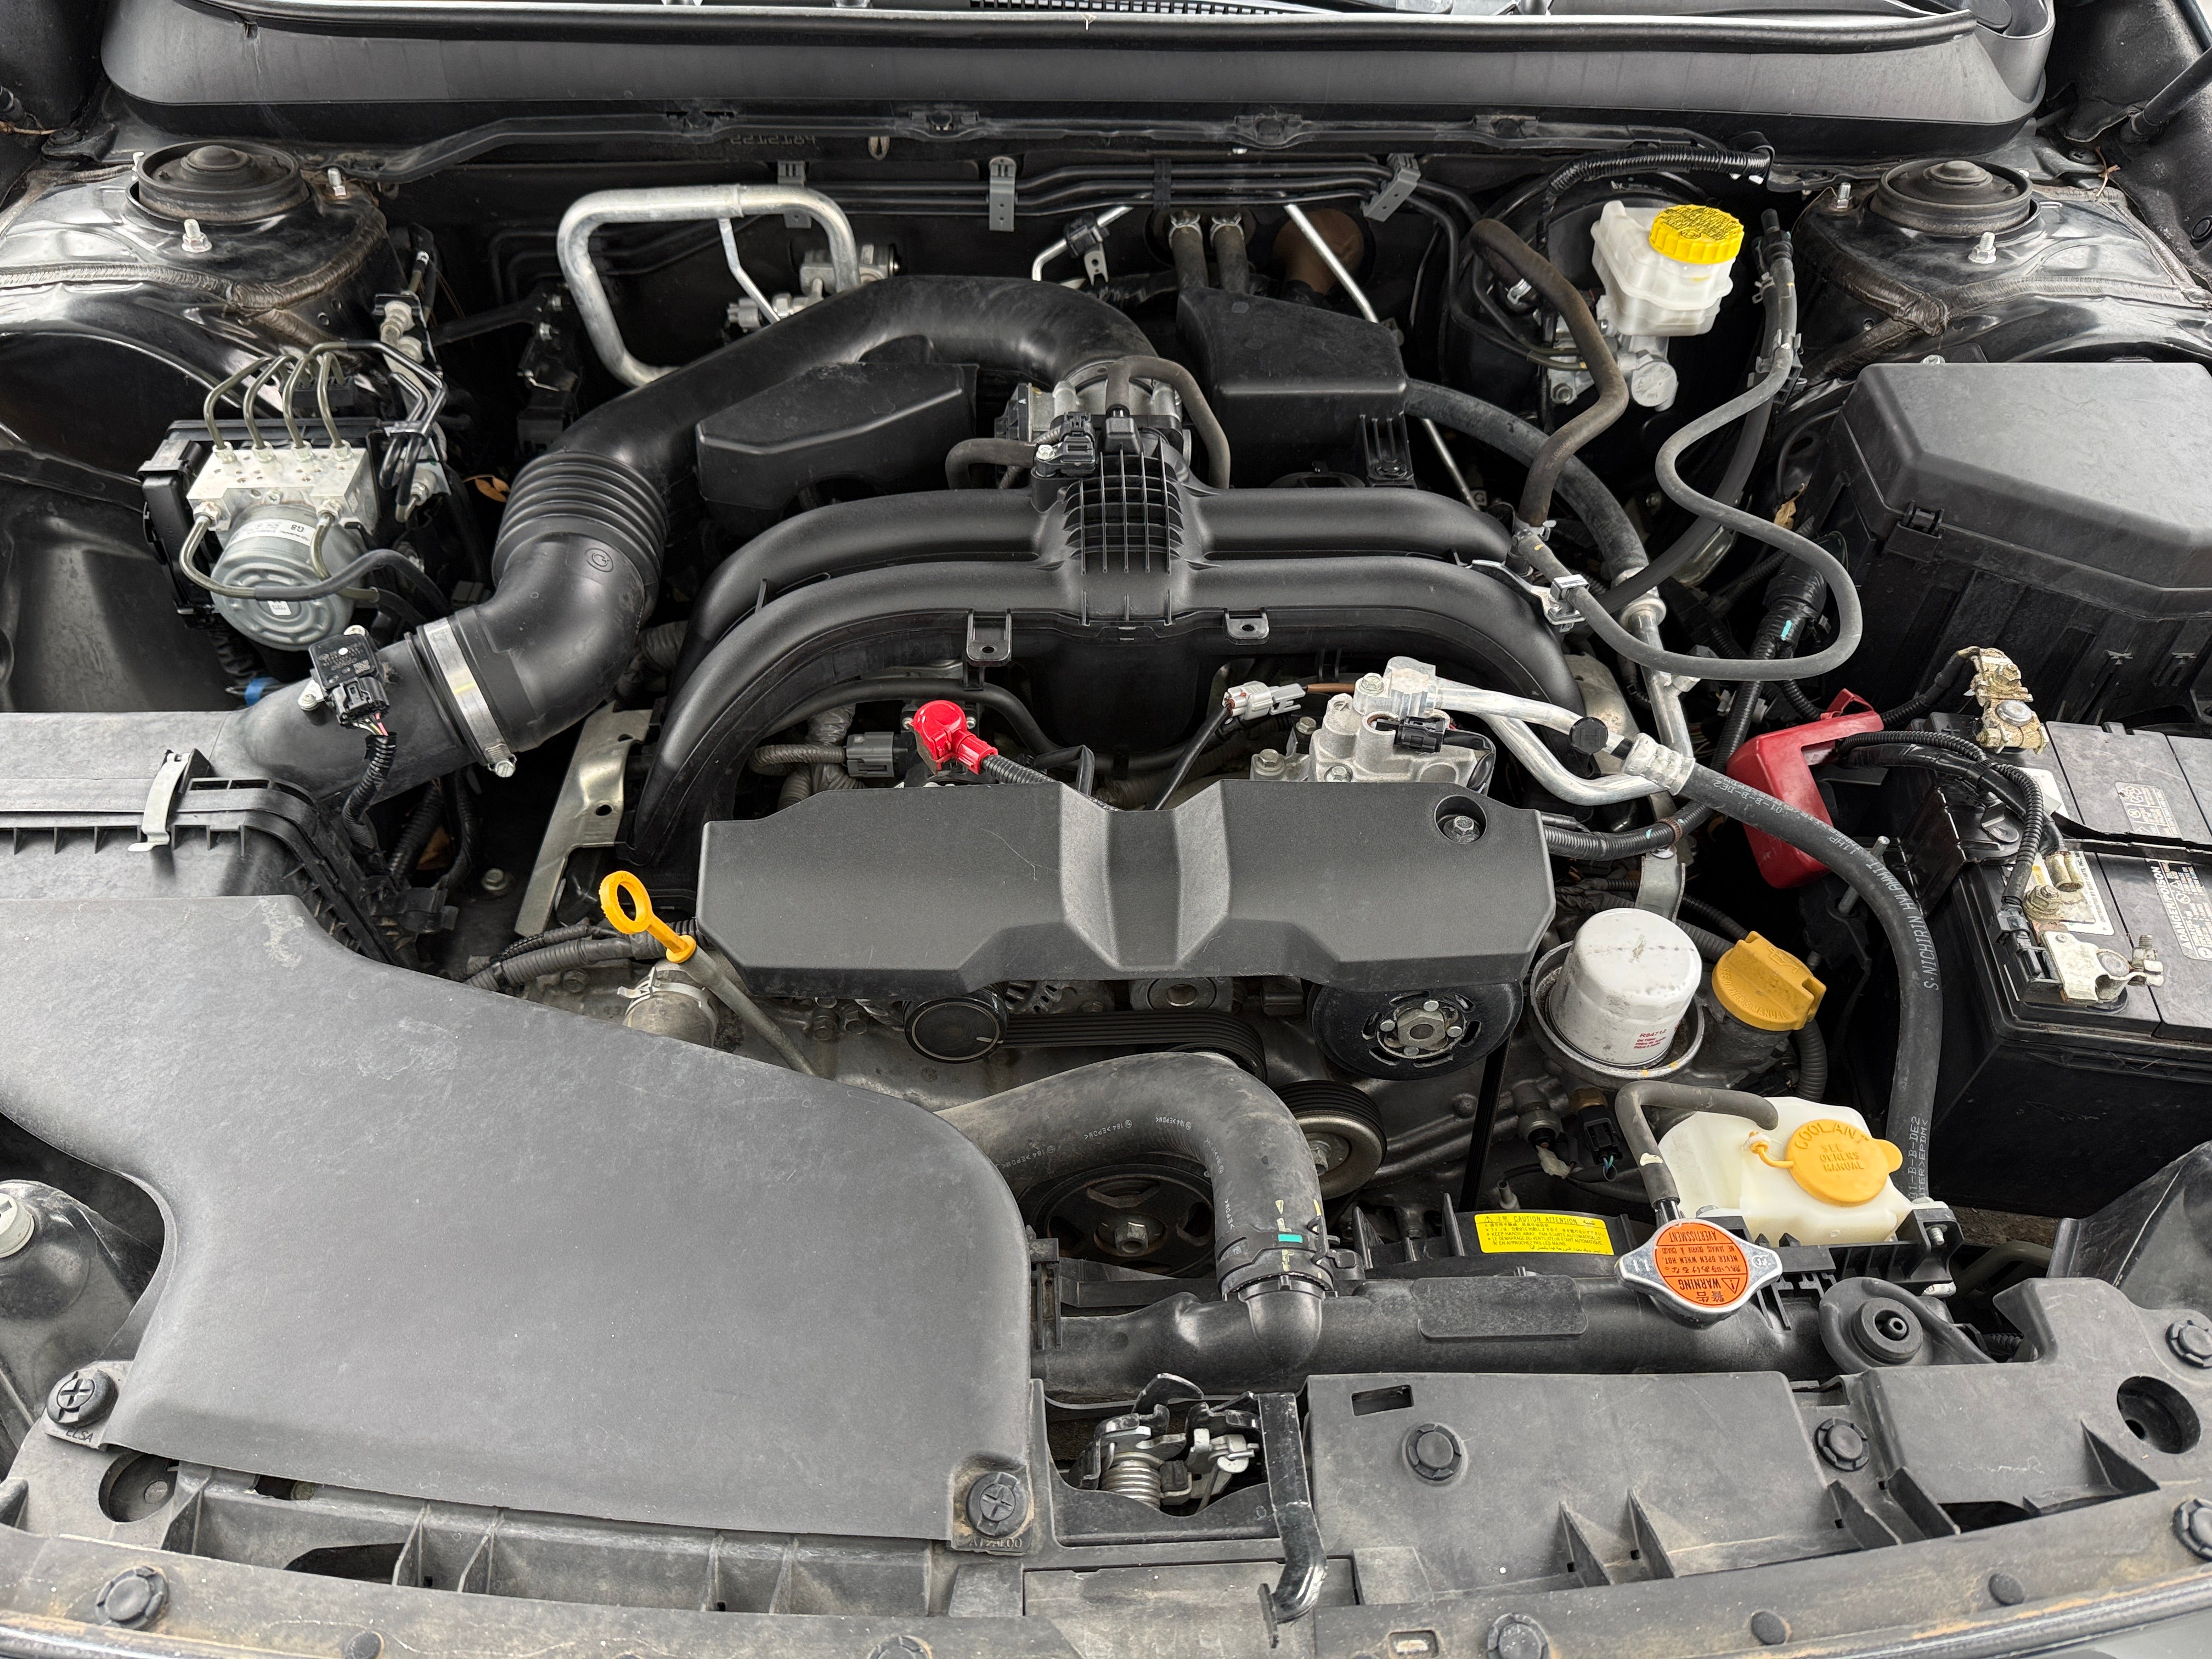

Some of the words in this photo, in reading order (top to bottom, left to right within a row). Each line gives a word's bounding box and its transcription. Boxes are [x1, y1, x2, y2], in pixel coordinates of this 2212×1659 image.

[2150, 866, 2190, 941] DANGER/POISON
[1720, 967, 1731, 979] SEE
[1751, 1005, 1787, 1019] MANUAL
[1795, 1122, 1869, 1150] COOLANT
[1821, 1144, 1842, 1153] SEE
[1823, 1161, 1865, 1172] MANUAL
[1545, 1217, 1577, 1225] ATTENTION
[1678, 1278, 1721, 1290] WARNING
